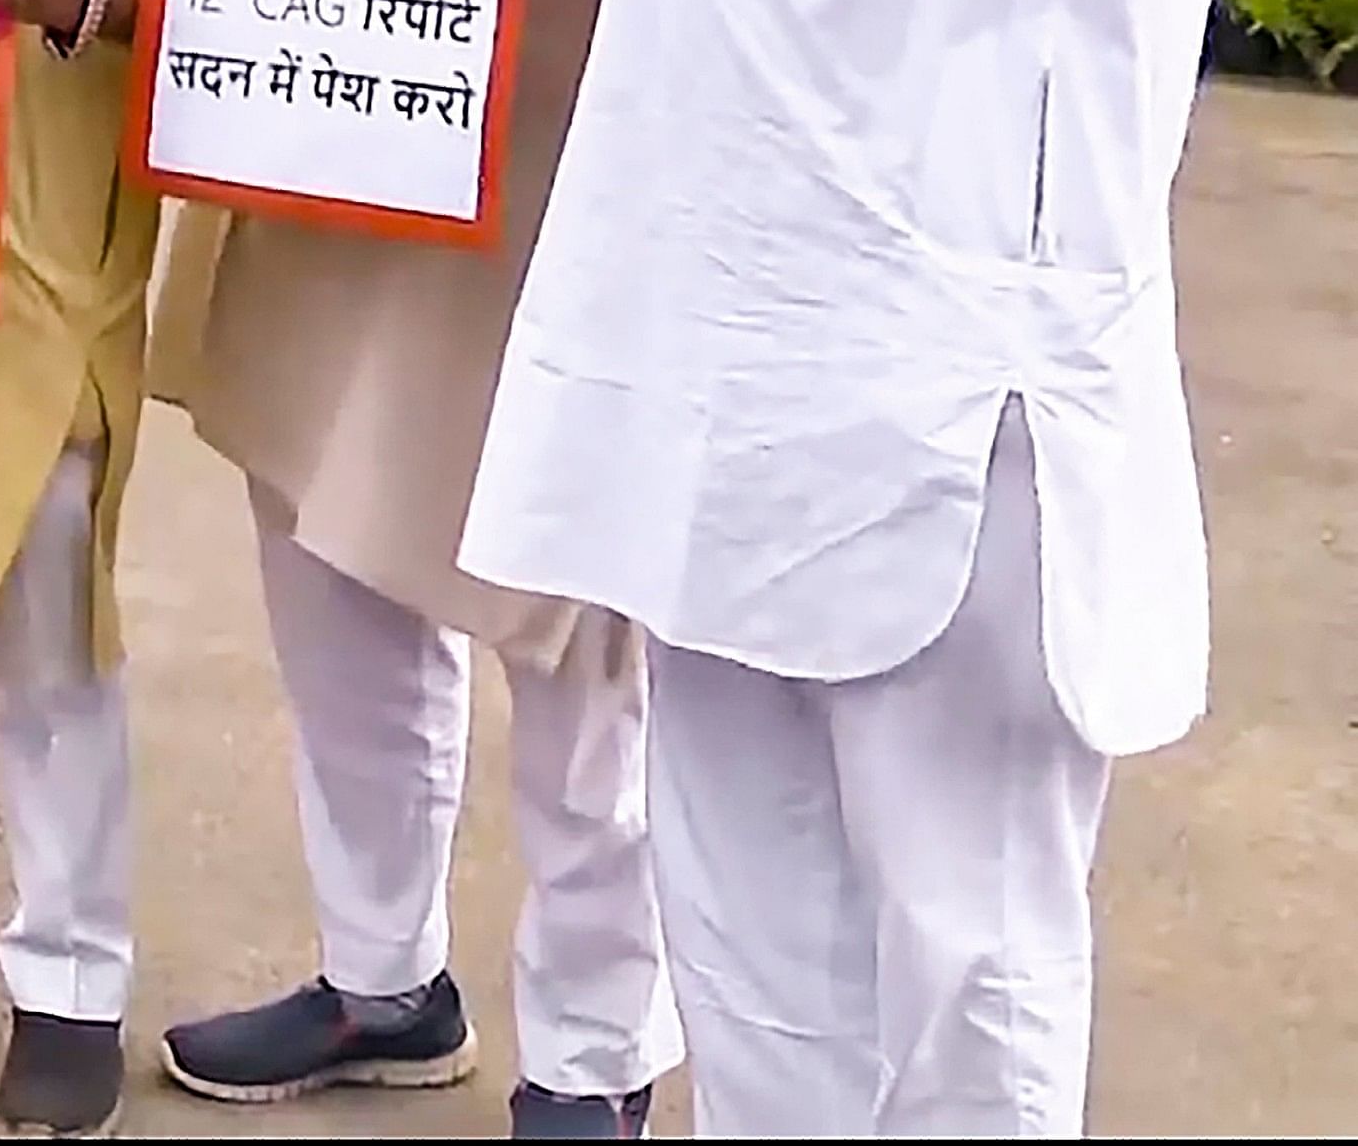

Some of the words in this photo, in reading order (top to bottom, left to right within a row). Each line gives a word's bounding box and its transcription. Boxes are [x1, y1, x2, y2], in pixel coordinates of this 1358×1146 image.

[167, 47, 258, 99] सदन
[267, 47, 303, 104] में
[311, 52, 382, 116] पेश
[390, 70, 477, 130] करो
